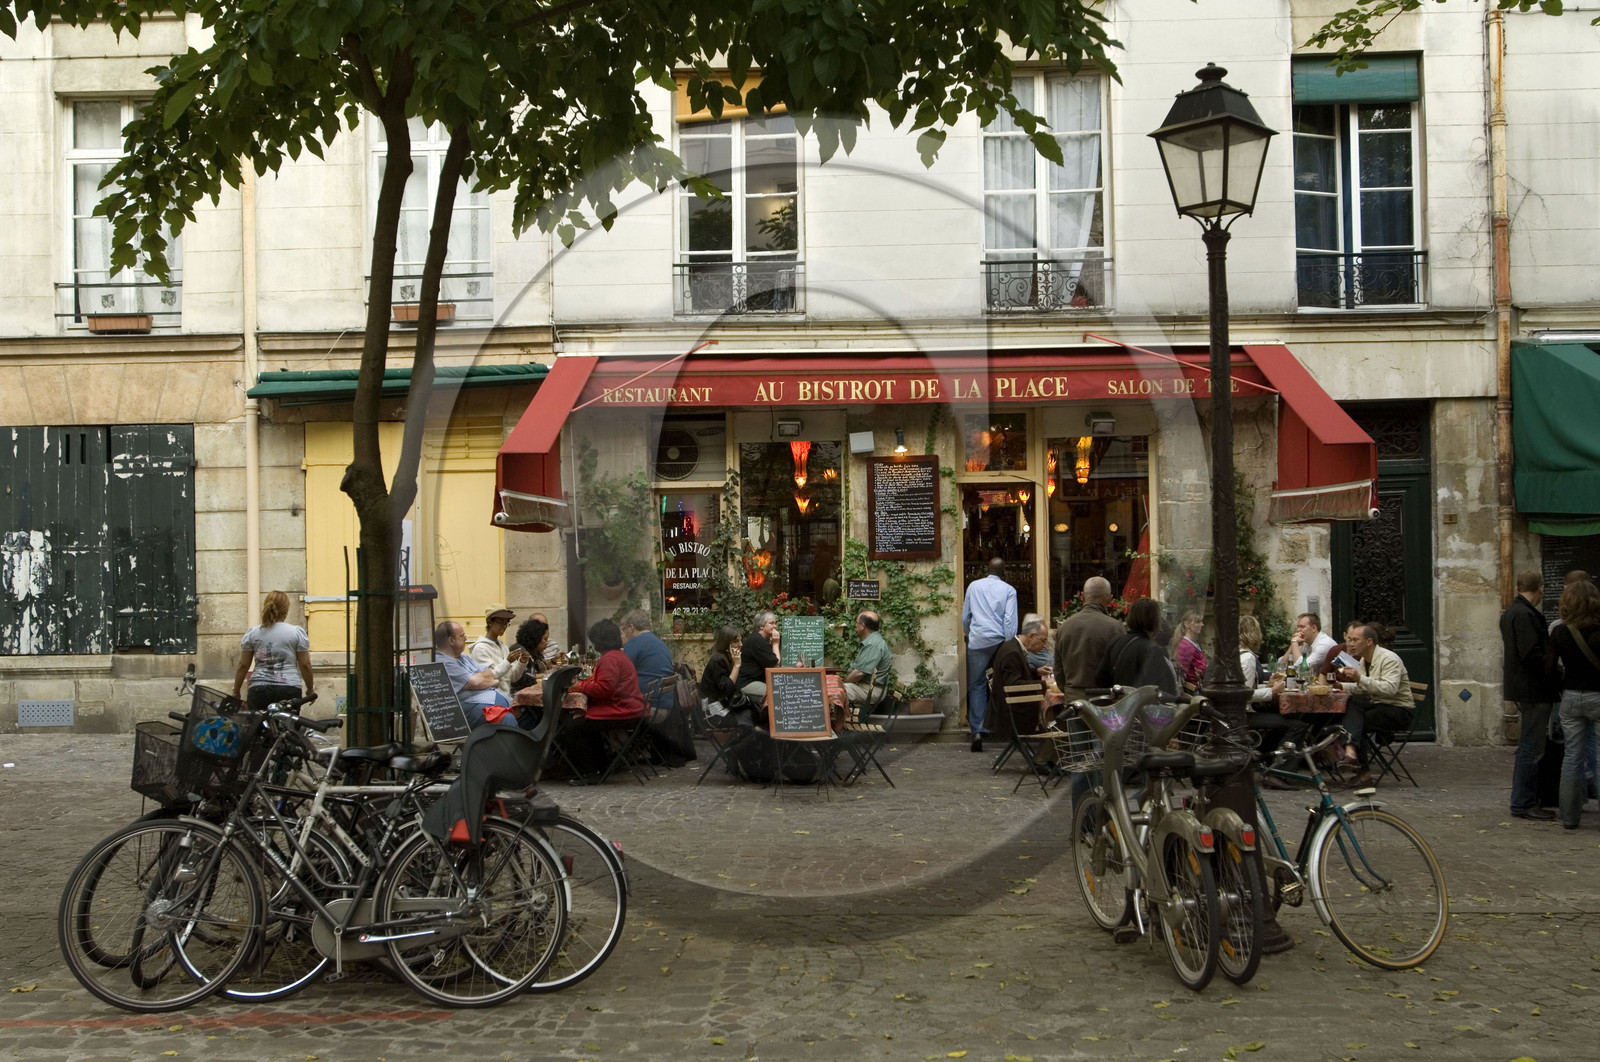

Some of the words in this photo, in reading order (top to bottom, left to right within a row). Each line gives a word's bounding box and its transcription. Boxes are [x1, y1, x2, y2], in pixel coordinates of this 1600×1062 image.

[754, 381, 784, 402] AU
[797, 379, 896, 401] BISTROT
[909, 378, 940, 399] DE
[953, 378, 982, 399] LA
[995, 376, 1069, 398] PLACE
[1107, 379, 1163, 395] SALON
[1173, 378, 1196, 394] DE
[1204, 378, 1240, 393] TE
[602, 387, 712, 403] RESTAURANT
[678, 541, 711, 557] BISTRO
[665, 567, 676, 578] DE
[679, 567, 689, 578] LA
